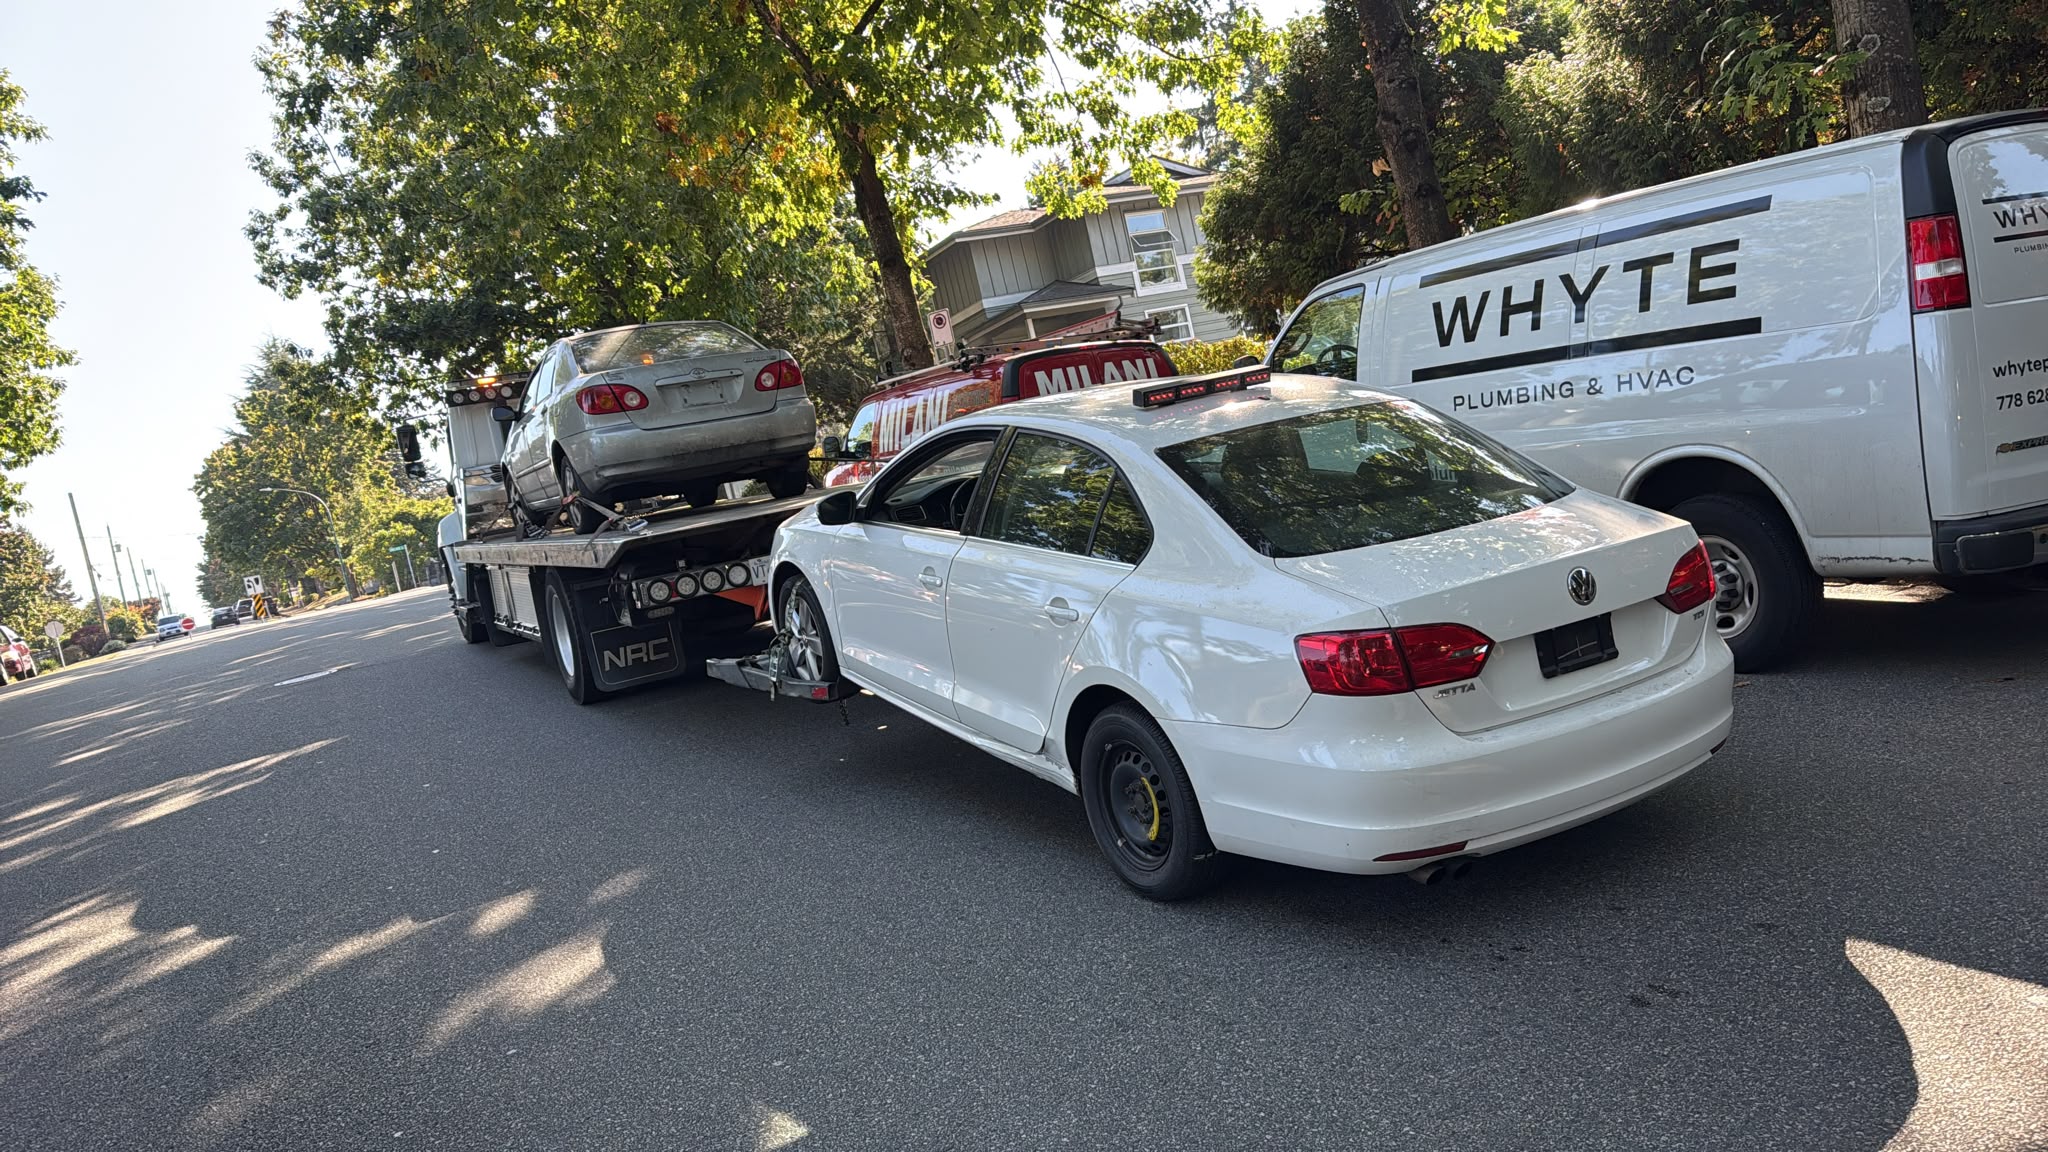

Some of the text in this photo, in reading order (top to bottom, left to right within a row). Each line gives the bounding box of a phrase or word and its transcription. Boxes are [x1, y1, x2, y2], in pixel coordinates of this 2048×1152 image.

[1432, 238, 1740, 348] WHYTE
[1034, 357, 1159, 398] MILANI
[1453, 366, 1695, 411] PLUMBING & HVAC
[1996, 393, 2023, 410] 778
[879, 390, 950, 454] MILANI
[751, 564, 770, 579] VT
[603, 637, 670, 672] NRC
[1432, 682, 1476, 700] JETTA
